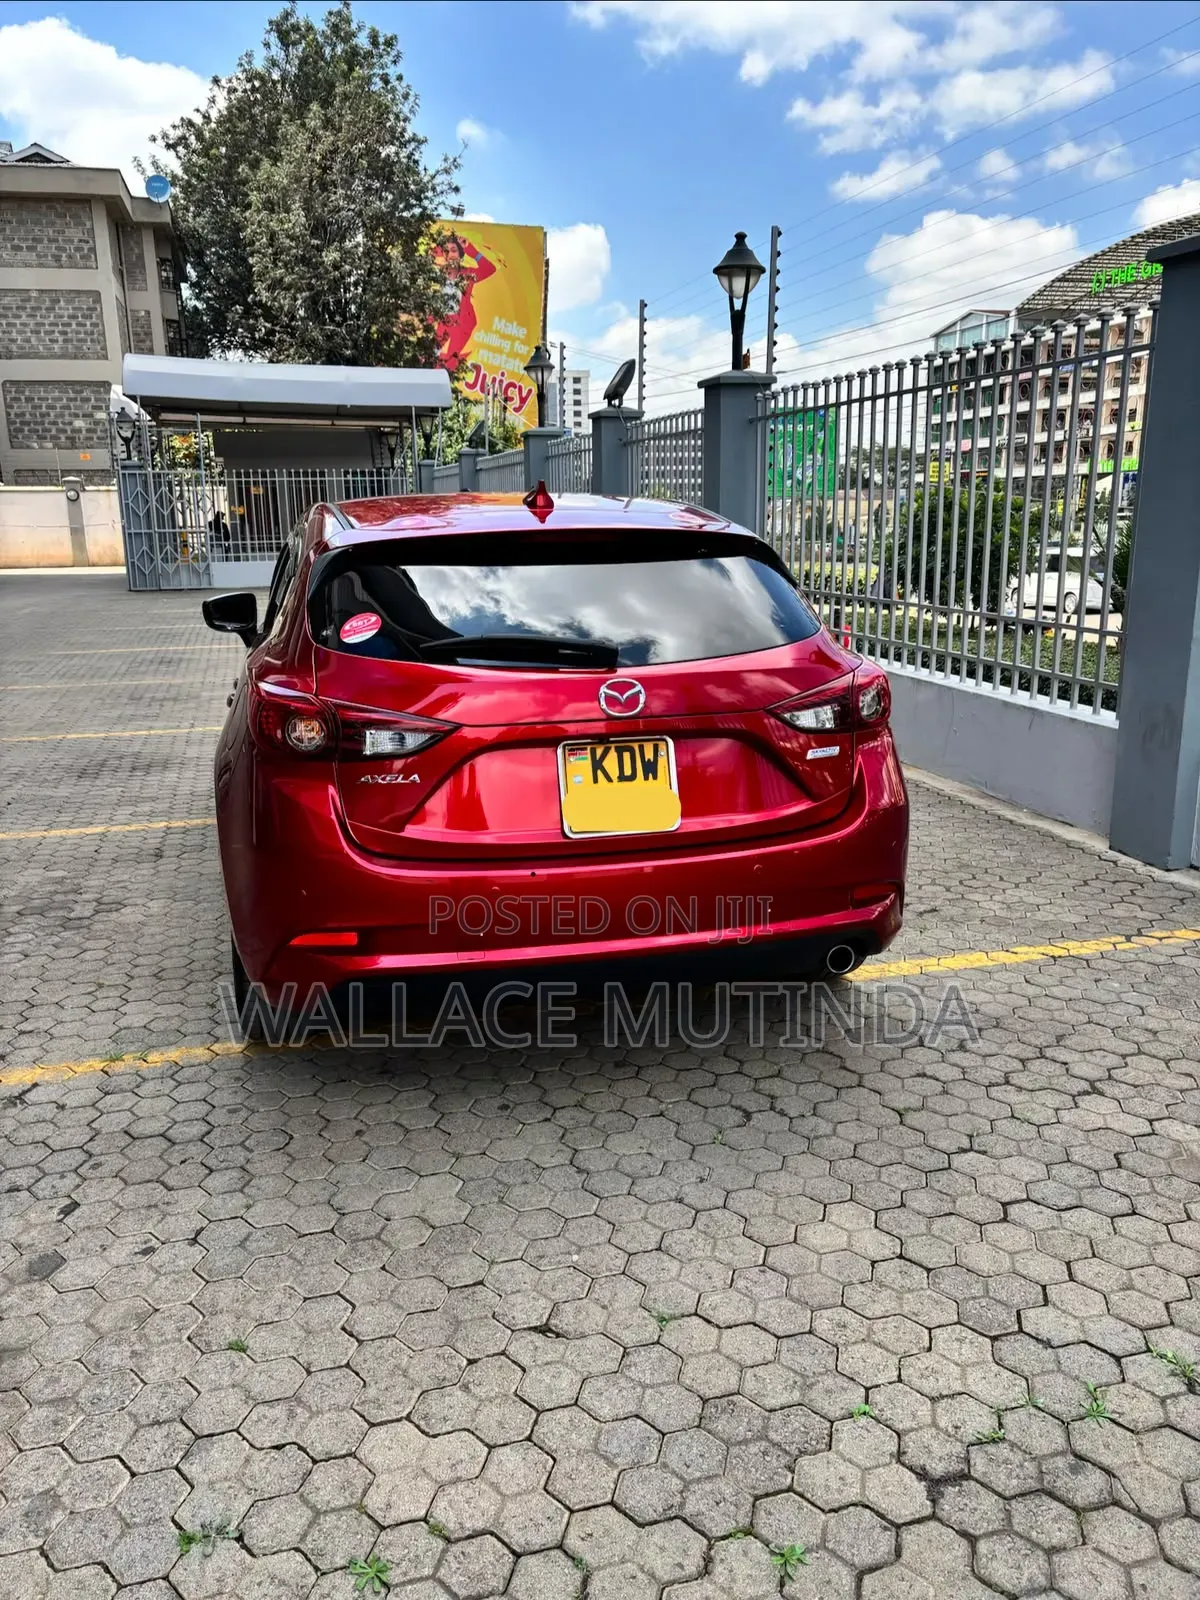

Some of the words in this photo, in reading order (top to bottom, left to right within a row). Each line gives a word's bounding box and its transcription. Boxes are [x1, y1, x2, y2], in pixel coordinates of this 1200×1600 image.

[1111, 262, 1137, 288] THE
[493, 315, 527, 339] Make
[473, 330, 511, 353] chilling
[514, 340, 530, 355] for
[464, 362, 533, 413] Juicy
[589, 743, 659, 784] KDW
[357, 774, 420, 784] AXELA
